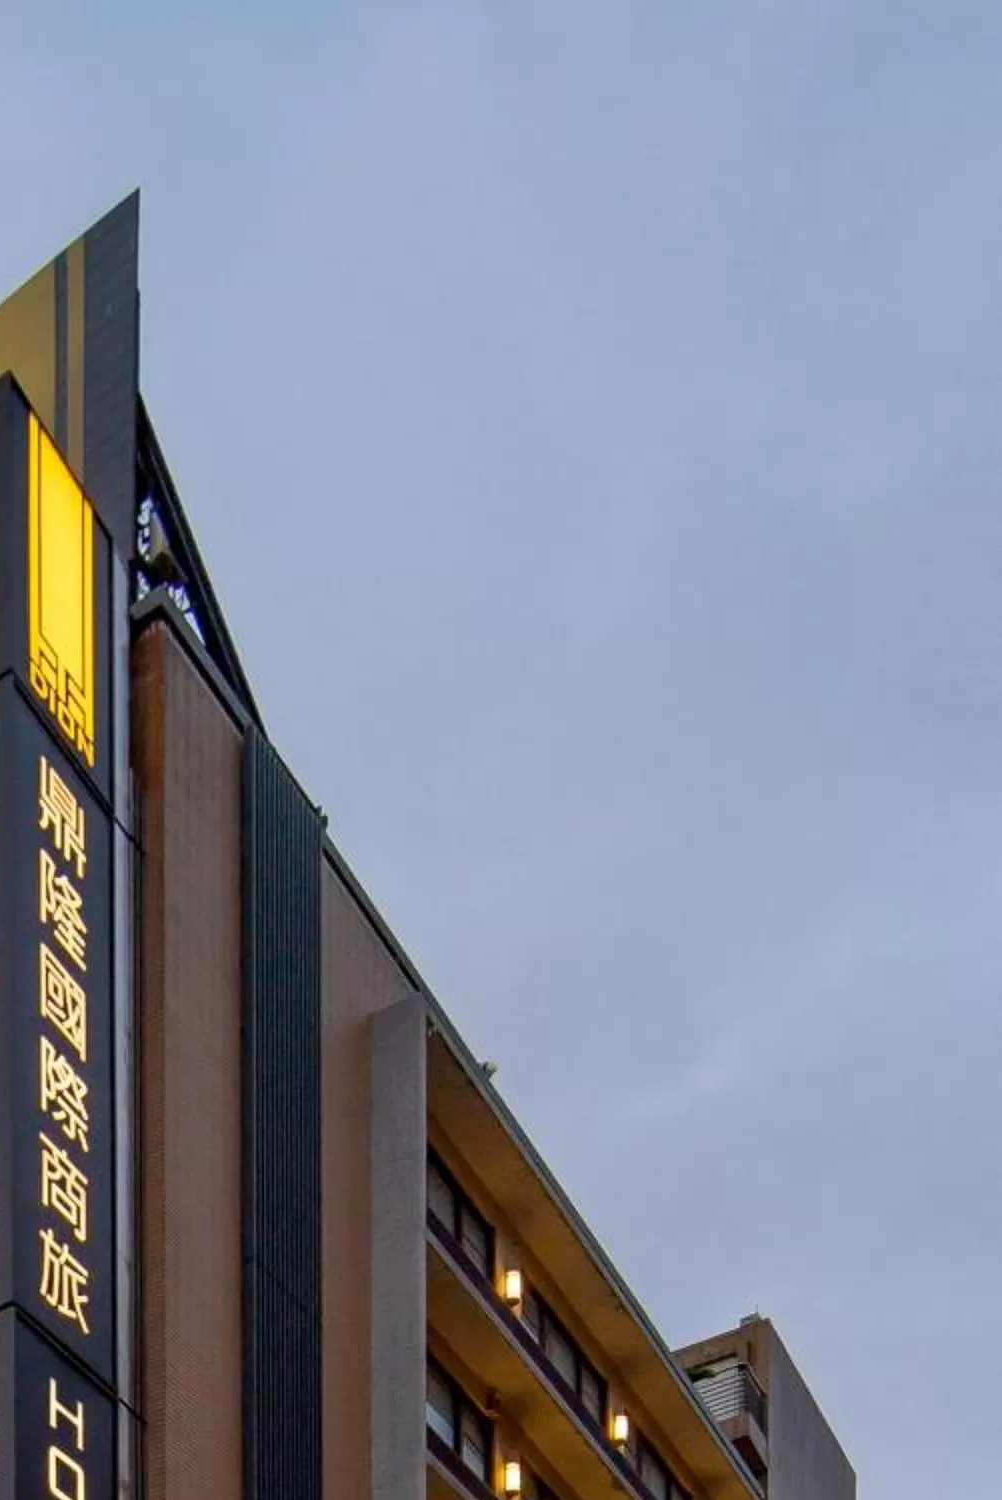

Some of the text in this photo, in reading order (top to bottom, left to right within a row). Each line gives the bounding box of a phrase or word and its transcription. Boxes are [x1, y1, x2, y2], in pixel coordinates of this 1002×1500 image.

[29, 660, 95, 769] DION
[38, 754, 89, 1335] 鼎隆國際商旅
